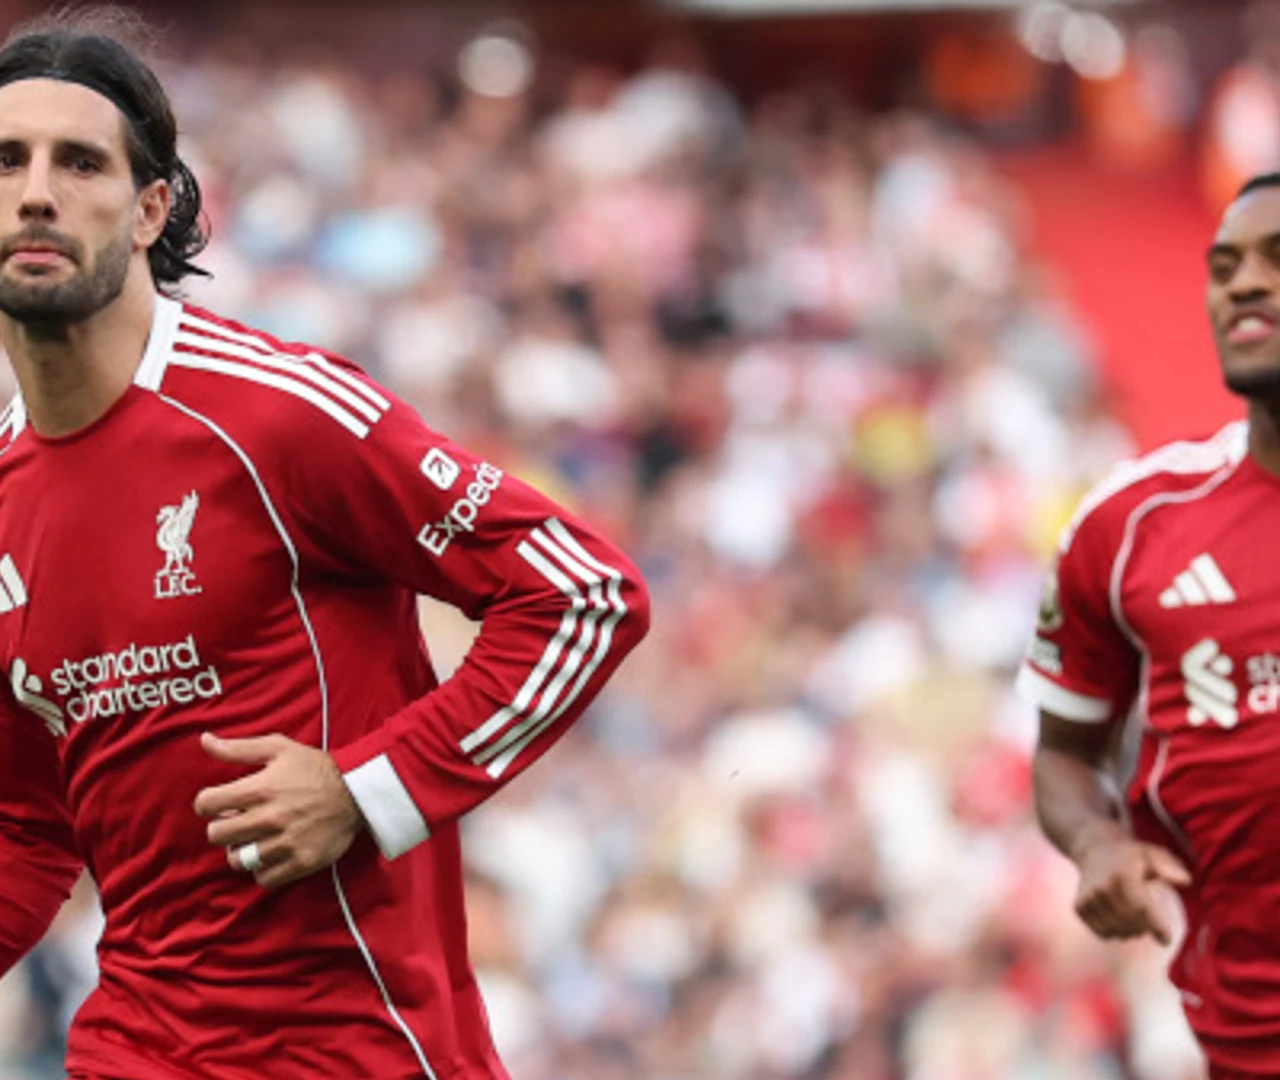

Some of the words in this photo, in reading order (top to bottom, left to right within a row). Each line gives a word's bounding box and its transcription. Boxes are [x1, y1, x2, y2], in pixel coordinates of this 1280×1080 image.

[417, 461, 504, 556] Exped
[51, 634, 199, 694] standard
[67, 665, 222, 723] chartered
